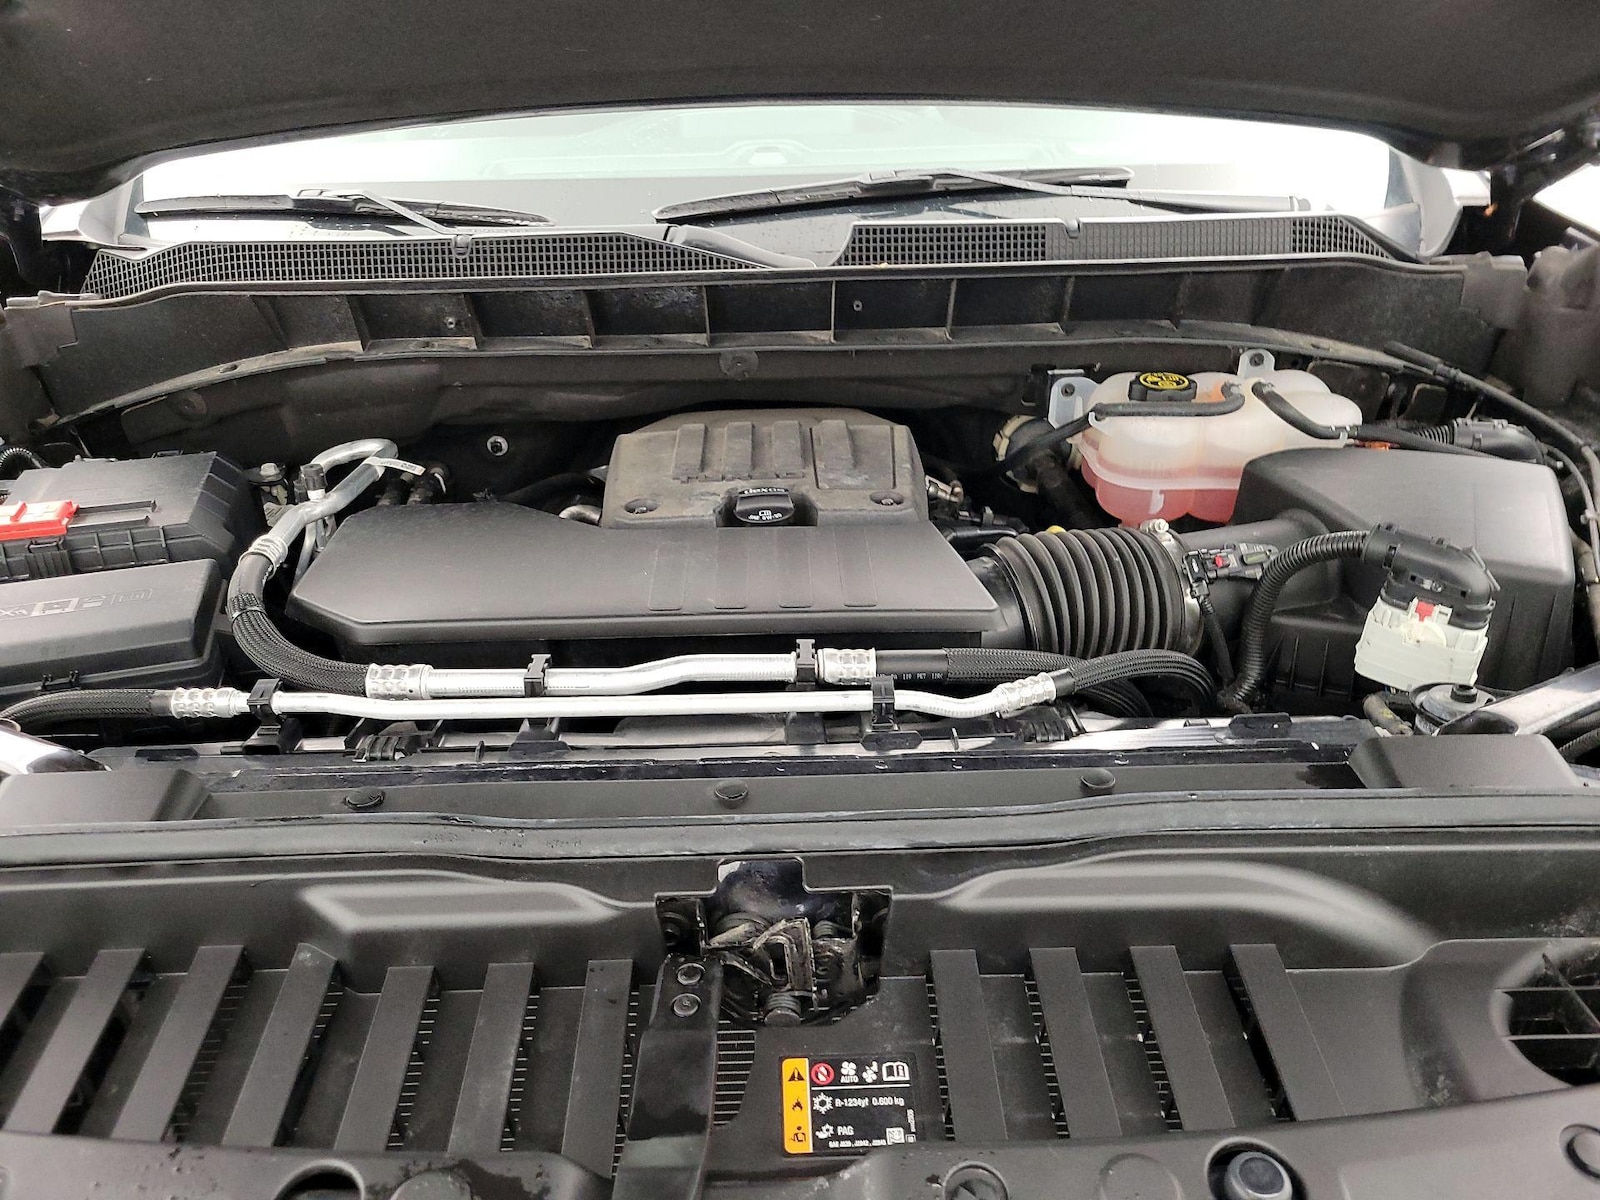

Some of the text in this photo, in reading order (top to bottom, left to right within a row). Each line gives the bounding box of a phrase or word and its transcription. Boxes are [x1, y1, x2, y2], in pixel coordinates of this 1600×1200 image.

[835, 1096, 905, 1107] R-1234yf 0.600 kg
[837, 1126, 854, 1135] PAG
